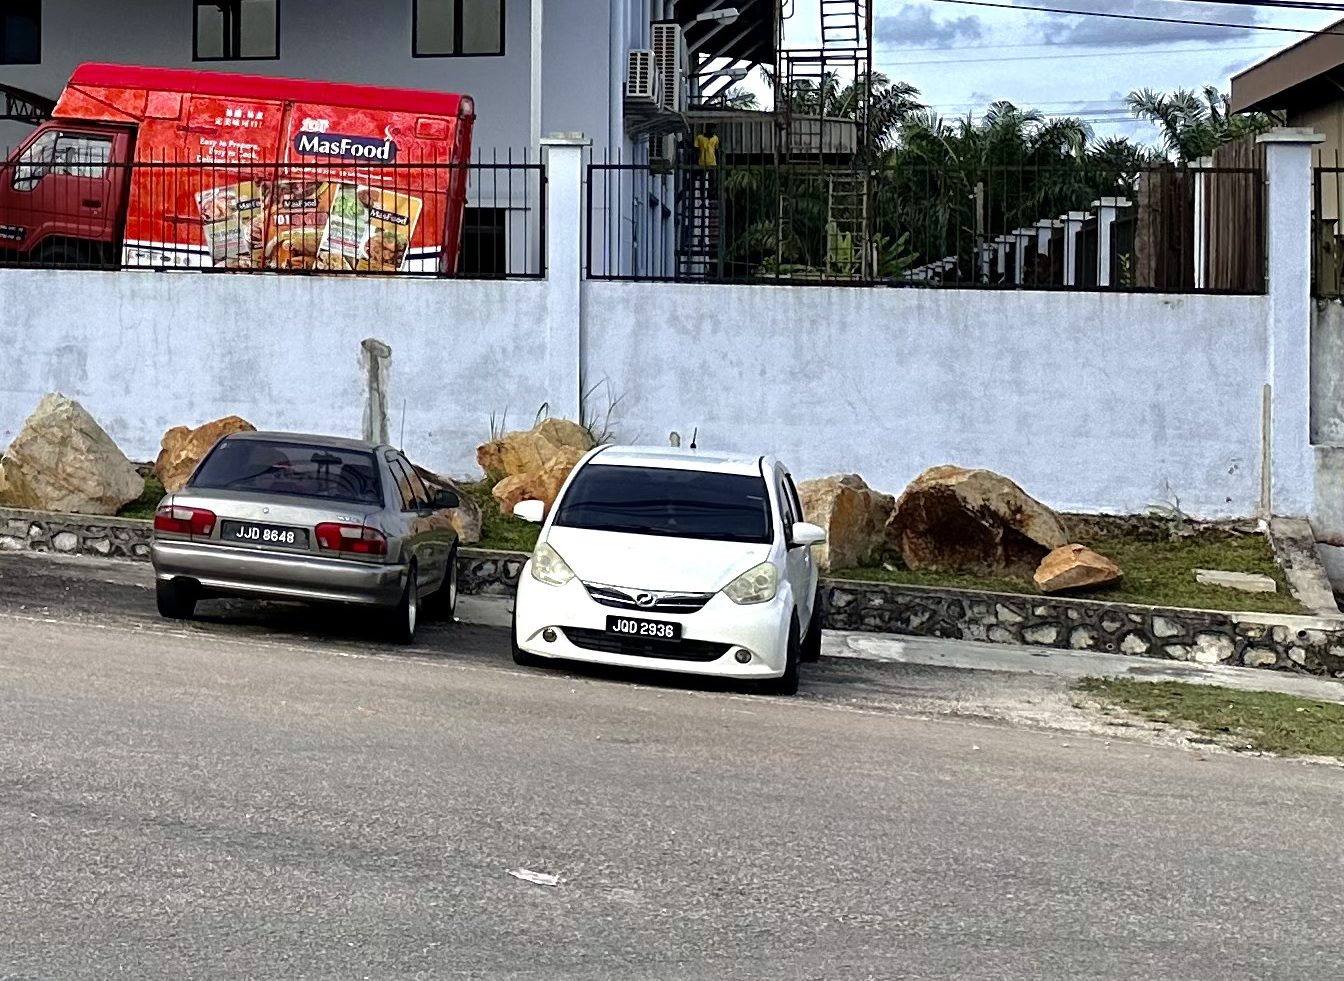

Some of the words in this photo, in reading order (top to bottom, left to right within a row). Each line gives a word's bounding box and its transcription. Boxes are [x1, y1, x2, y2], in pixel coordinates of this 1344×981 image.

[298, 134, 390, 160] MasFood
[236, 526, 260, 540] JJD
[263, 529, 294, 544] 8648
[612, 619, 638, 634] JQD
[640, 622, 674, 637] 2936
